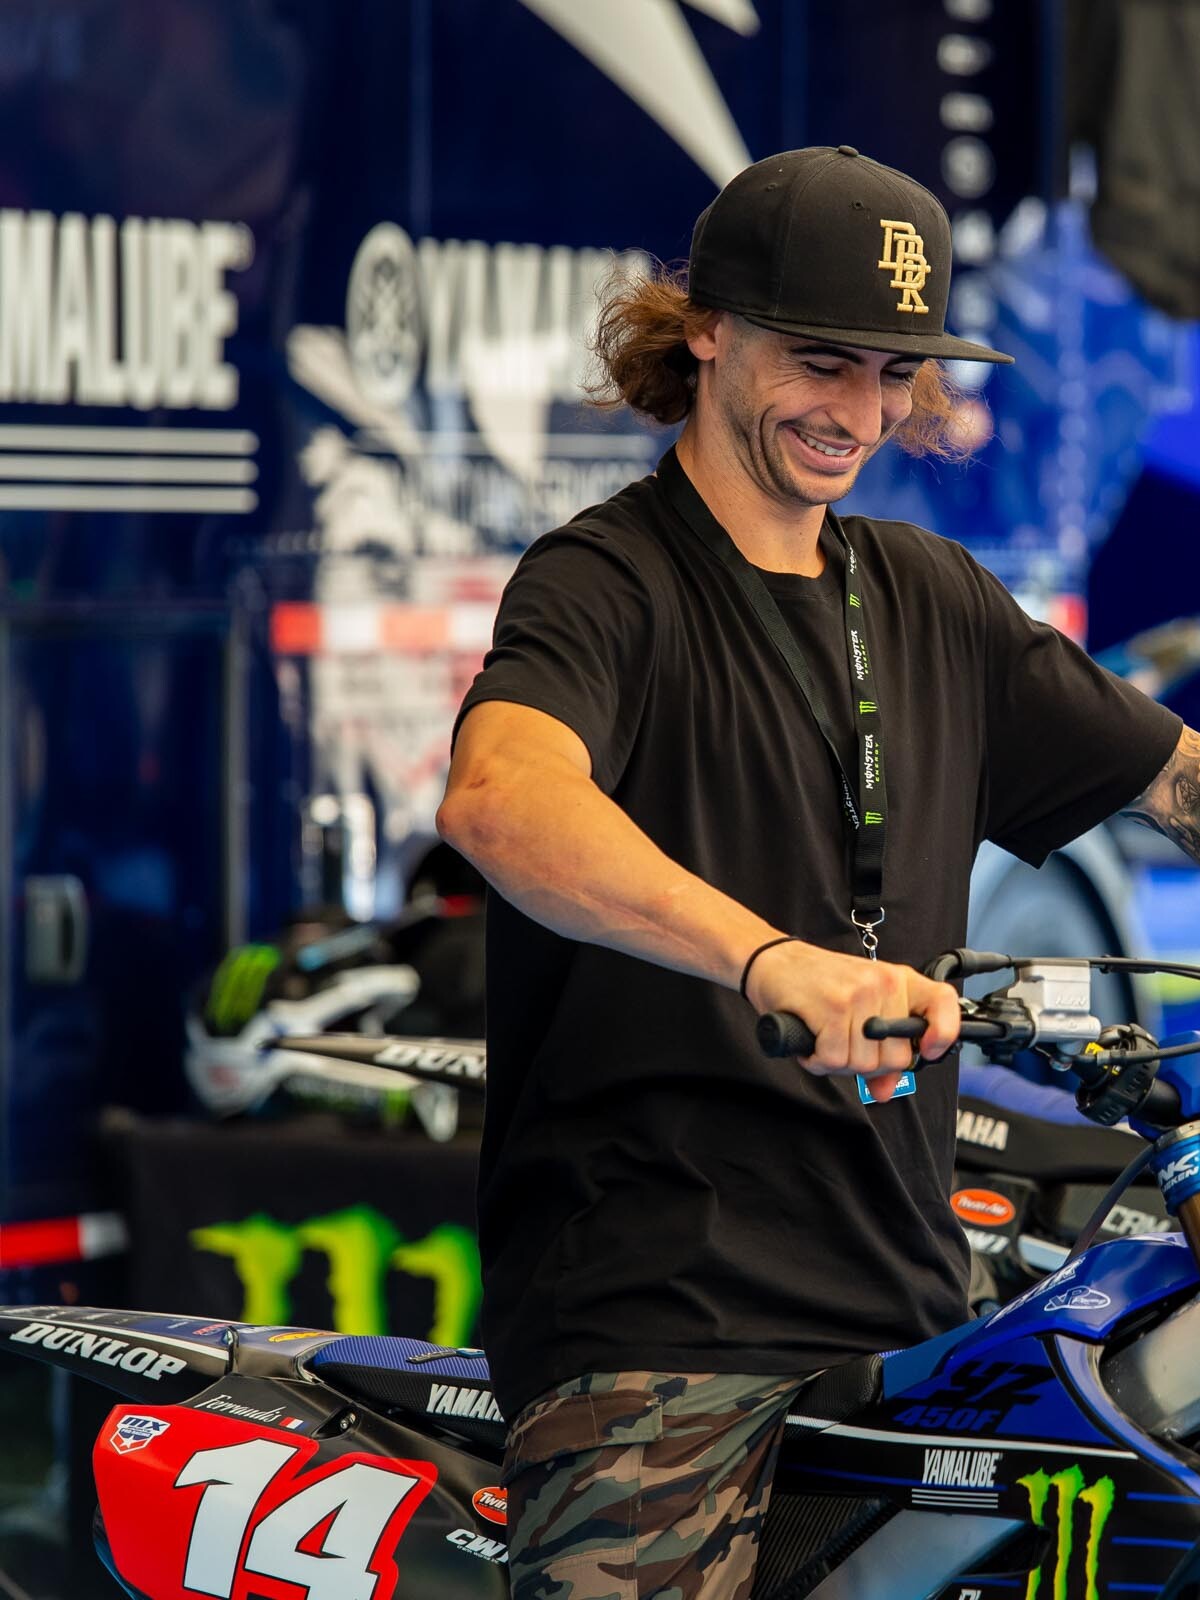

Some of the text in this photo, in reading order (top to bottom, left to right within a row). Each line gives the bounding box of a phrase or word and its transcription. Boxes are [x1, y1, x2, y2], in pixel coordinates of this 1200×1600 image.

[864, 733, 875, 790] MONSTER
[9, 1322, 188, 1381] DUNLOP
[426, 1383, 505, 1423] YAMAH
[921, 1448, 998, 1488] YAMALUBE
[173, 1437, 420, 1600] 14
